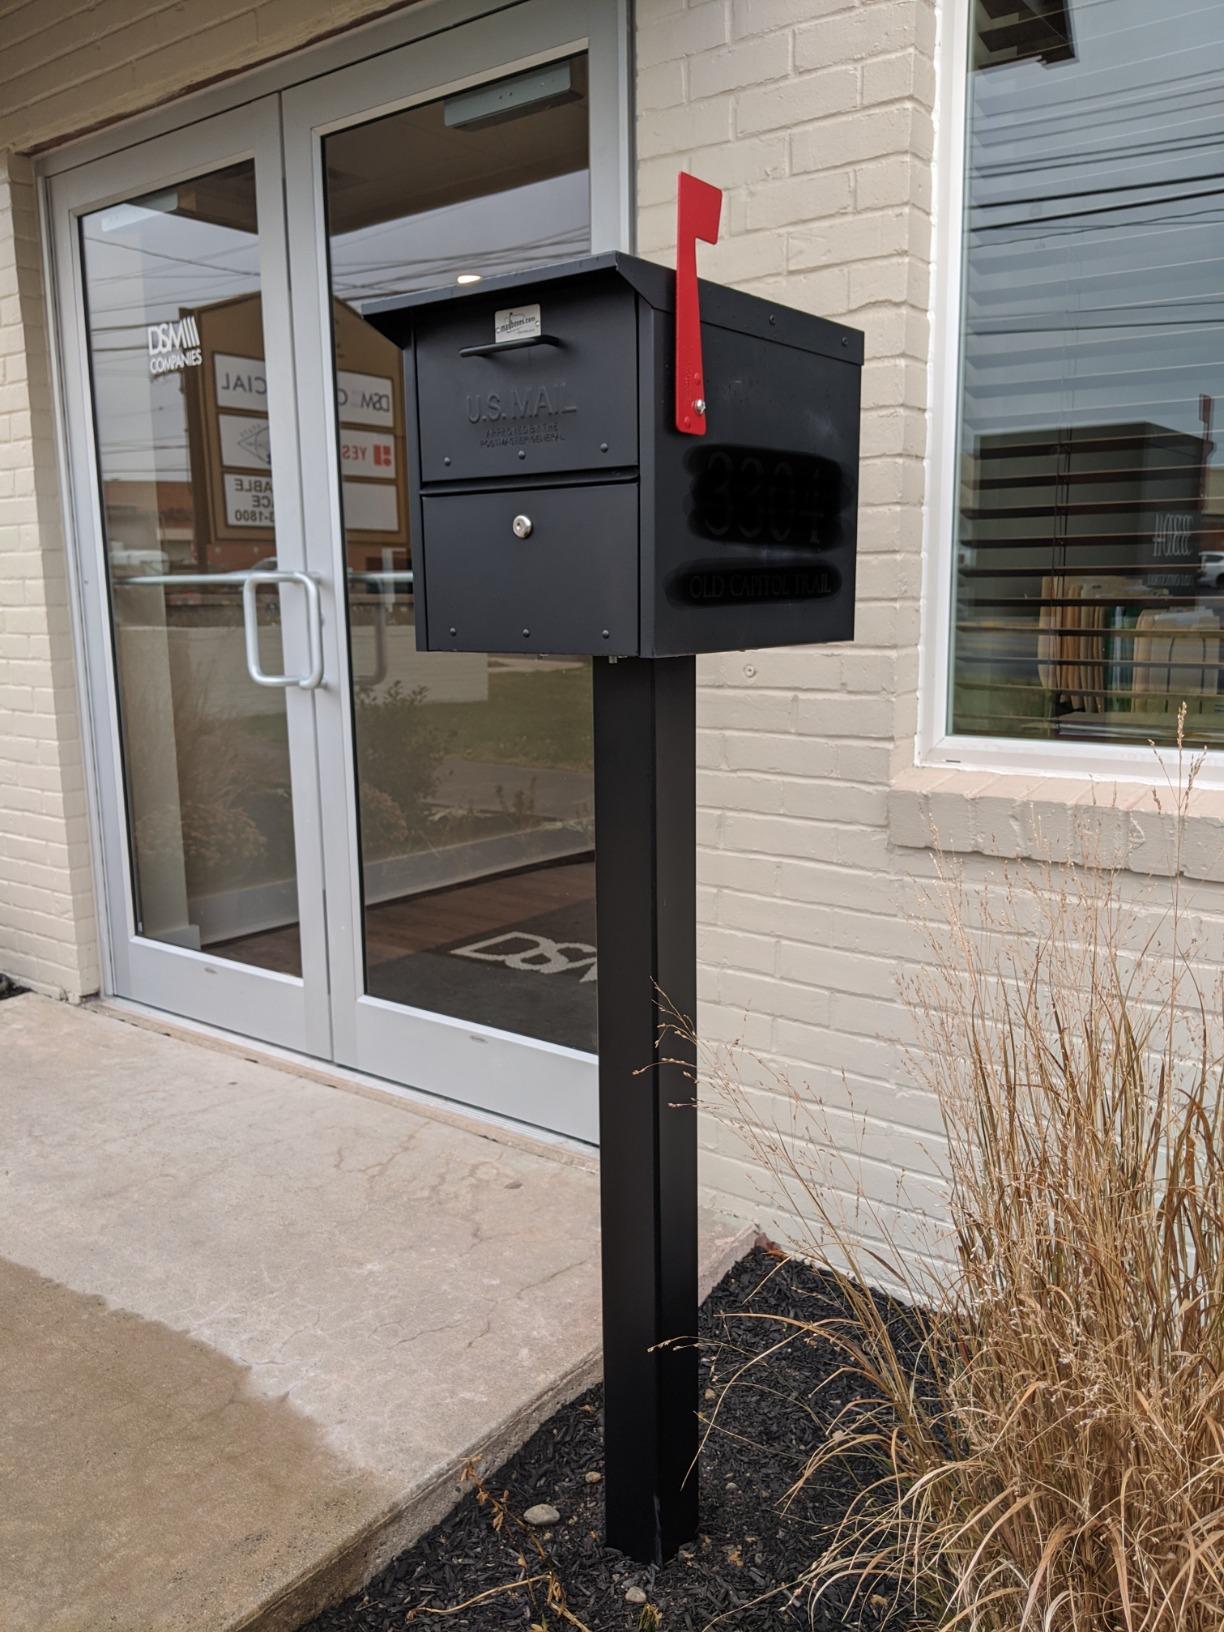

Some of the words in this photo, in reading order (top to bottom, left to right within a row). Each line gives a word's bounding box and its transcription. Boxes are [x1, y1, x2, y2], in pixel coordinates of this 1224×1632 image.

[150, 348, 203, 374] COMPANIES
[467, 393, 508, 425] U.S.
[511, 382, 578, 420] MAIL
[449, 931, 597, 983] DS
